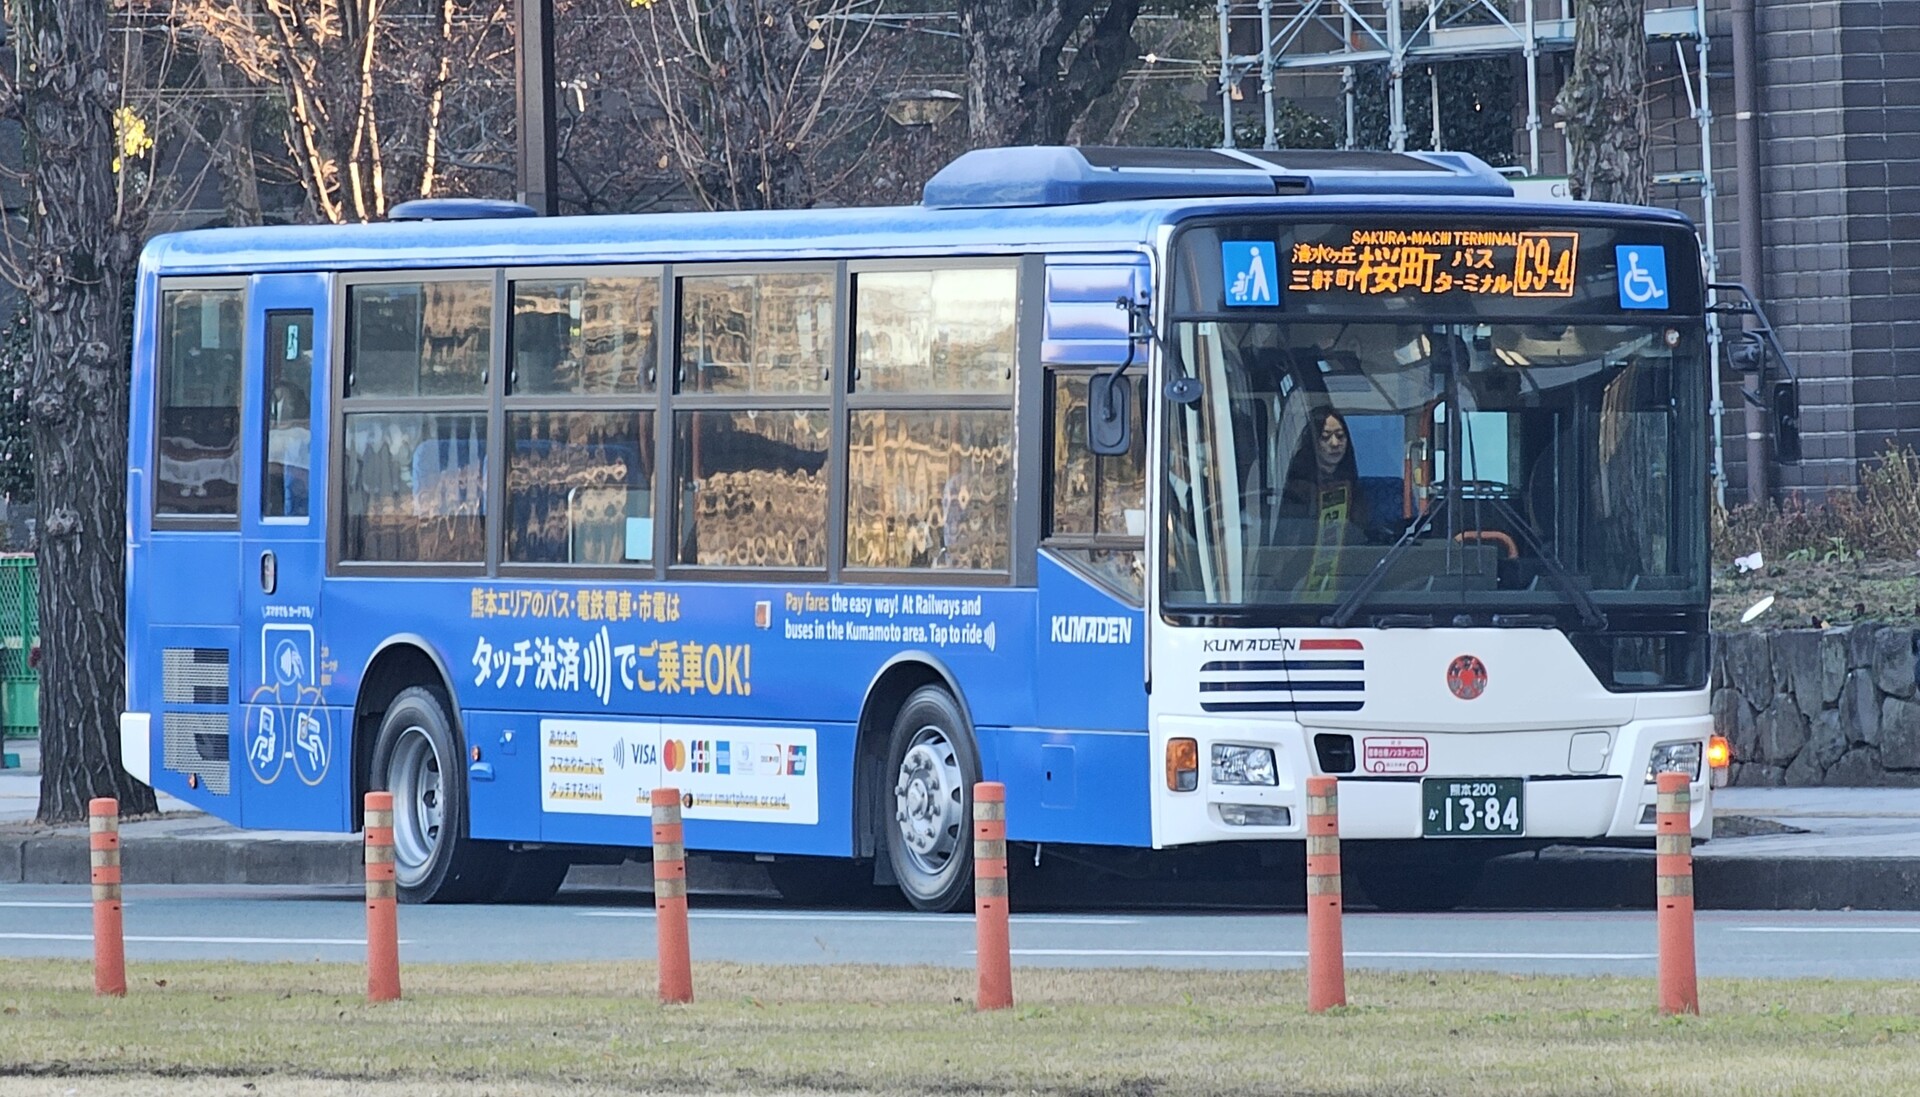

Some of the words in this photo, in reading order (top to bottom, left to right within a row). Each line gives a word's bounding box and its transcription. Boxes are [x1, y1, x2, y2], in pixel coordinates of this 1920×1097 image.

[1352, 231, 1451, 246] SAKURA-MACHI
[1453, 231, 1519, 246] TERMINAL
[1354, 246, 1441, 294] 桜町
[1451, 249, 1495, 269] バス
[1517, 238, 1571, 292] C9-4
[1433, 272, 1514, 294] ターミナル
[471, 587, 681, 623] 熊本エリアのバス・電鉄電車・市電は
[786, 592, 803, 614] Pay
[805, 592, 829, 612] fares
[831, 592, 848, 613] the
[849, 596, 872, 618] easy
[875, 594, 899, 618] way!
[902, 594, 914, 614] At
[915, 594, 960, 620] Railways
[961, 595, 981, 616] and
[785, 618, 814, 640] buses
[815, 619, 825, 640] in
[827, 618, 844, 640] the
[846, 621, 901, 642] Kumamoto
[902, 624, 928, 643] area.
[929, 622, 948, 647] Tap
[949, 624, 961, 644] to
[962, 622, 982, 644] ride
[1051, 615, 1132, 644] KUMADEN
[1203, 638, 1296, 652] KUMADEN
[472, 635, 580, 692] タッチ決済
[631, 743, 657, 765] VISA
